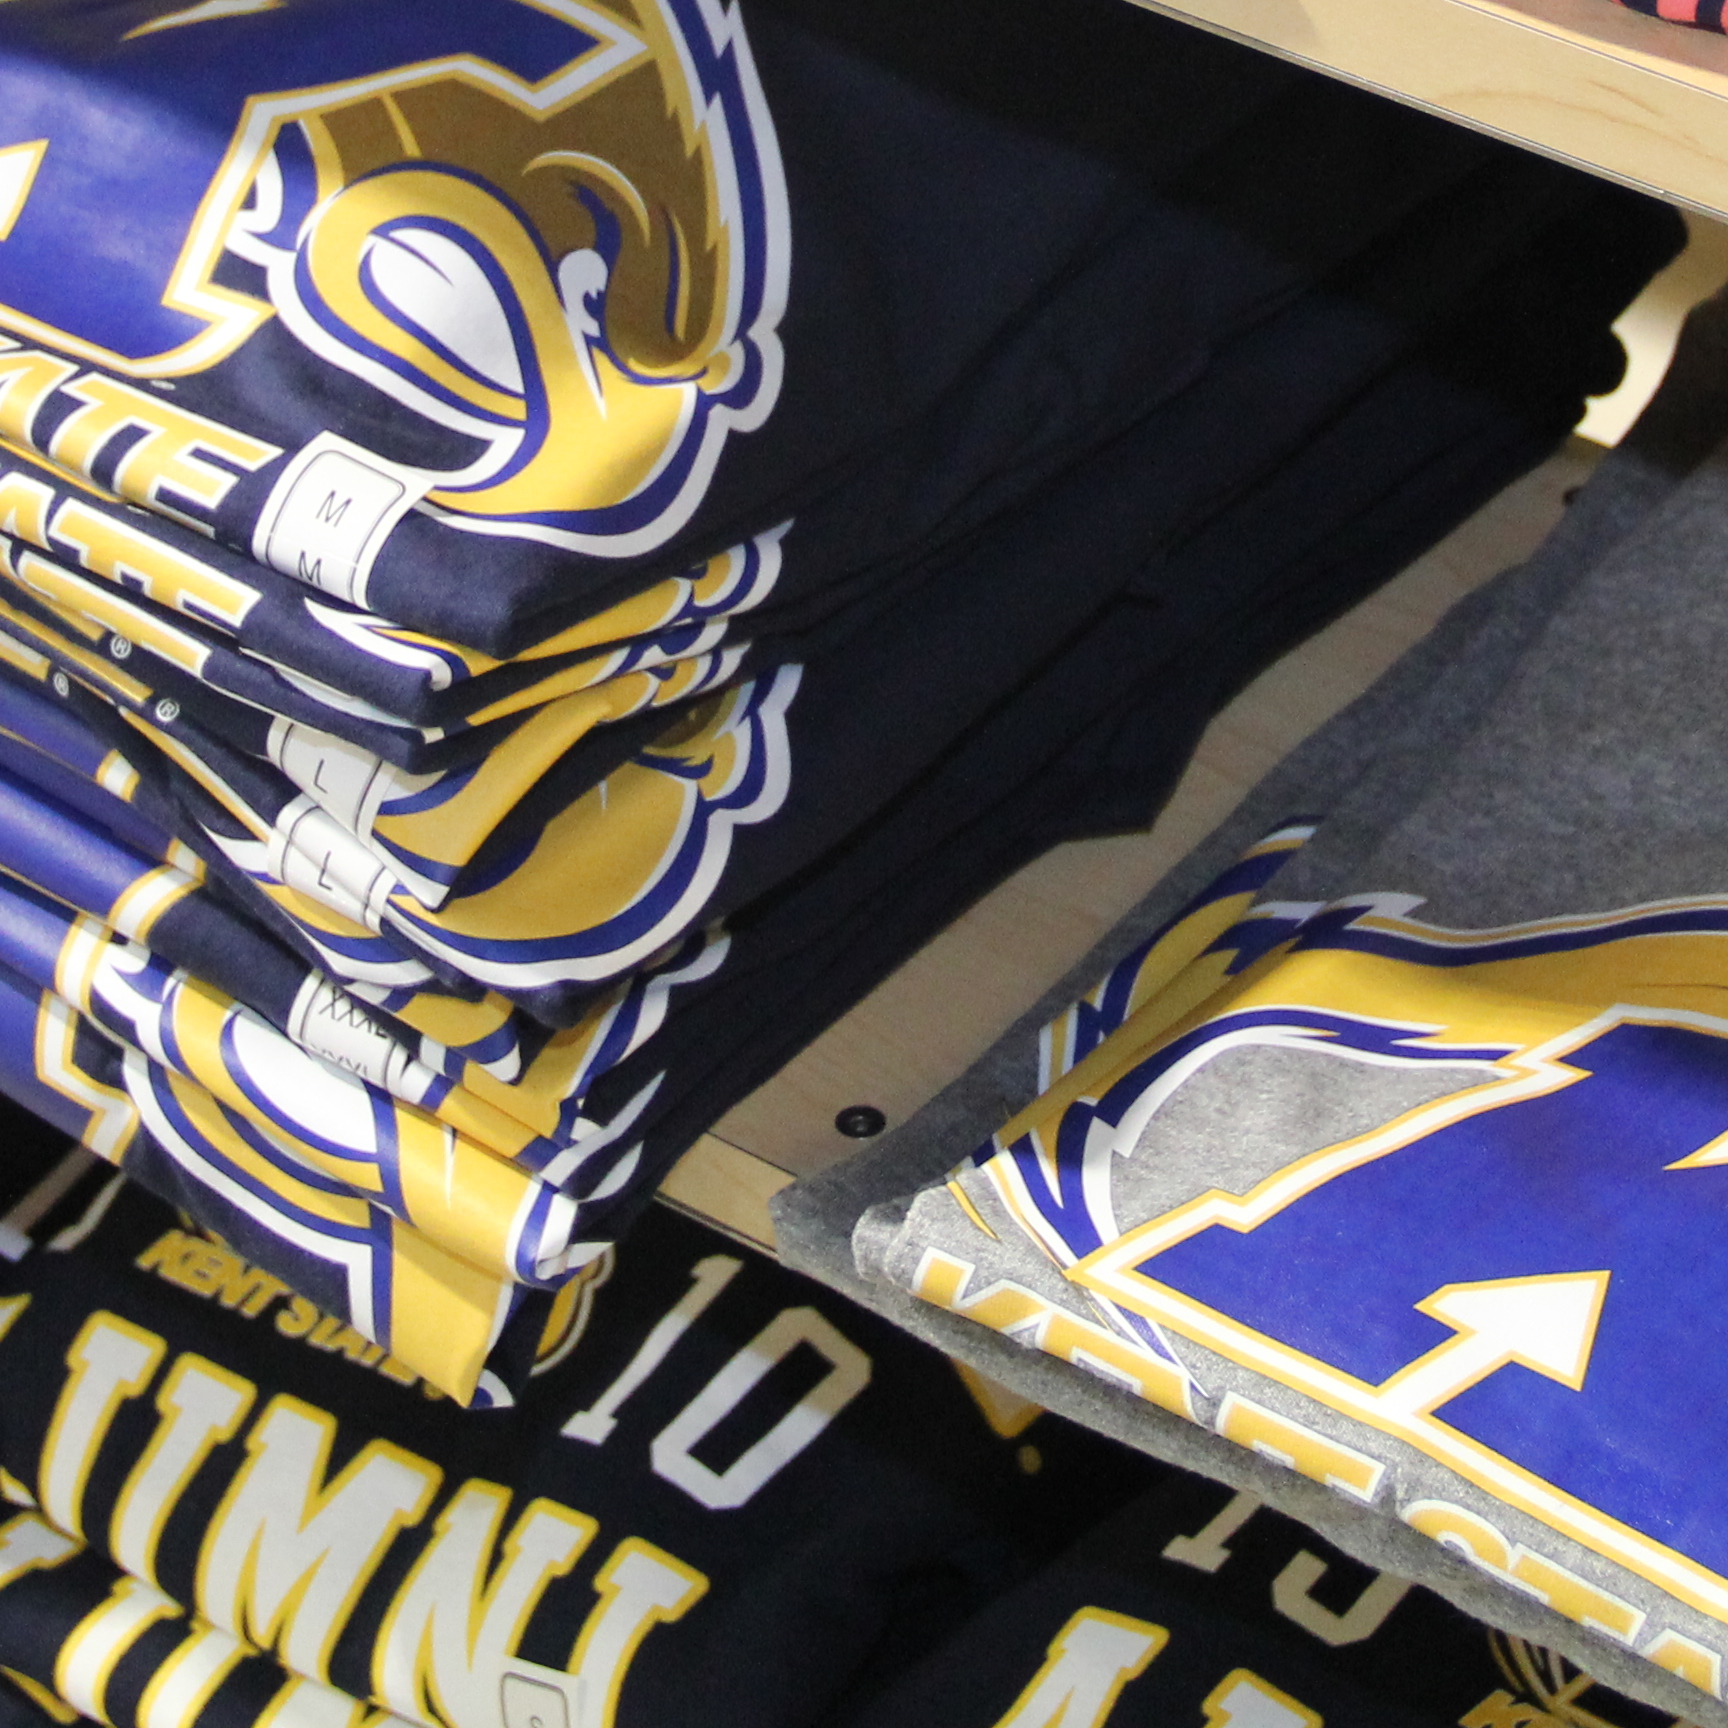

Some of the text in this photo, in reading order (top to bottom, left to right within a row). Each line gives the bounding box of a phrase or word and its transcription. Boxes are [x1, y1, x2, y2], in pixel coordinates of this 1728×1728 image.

[315, 489, 353, 528] M
[297, 549, 323, 587] M
[312, 758, 329, 795] L
[317, 850, 334, 891] L
